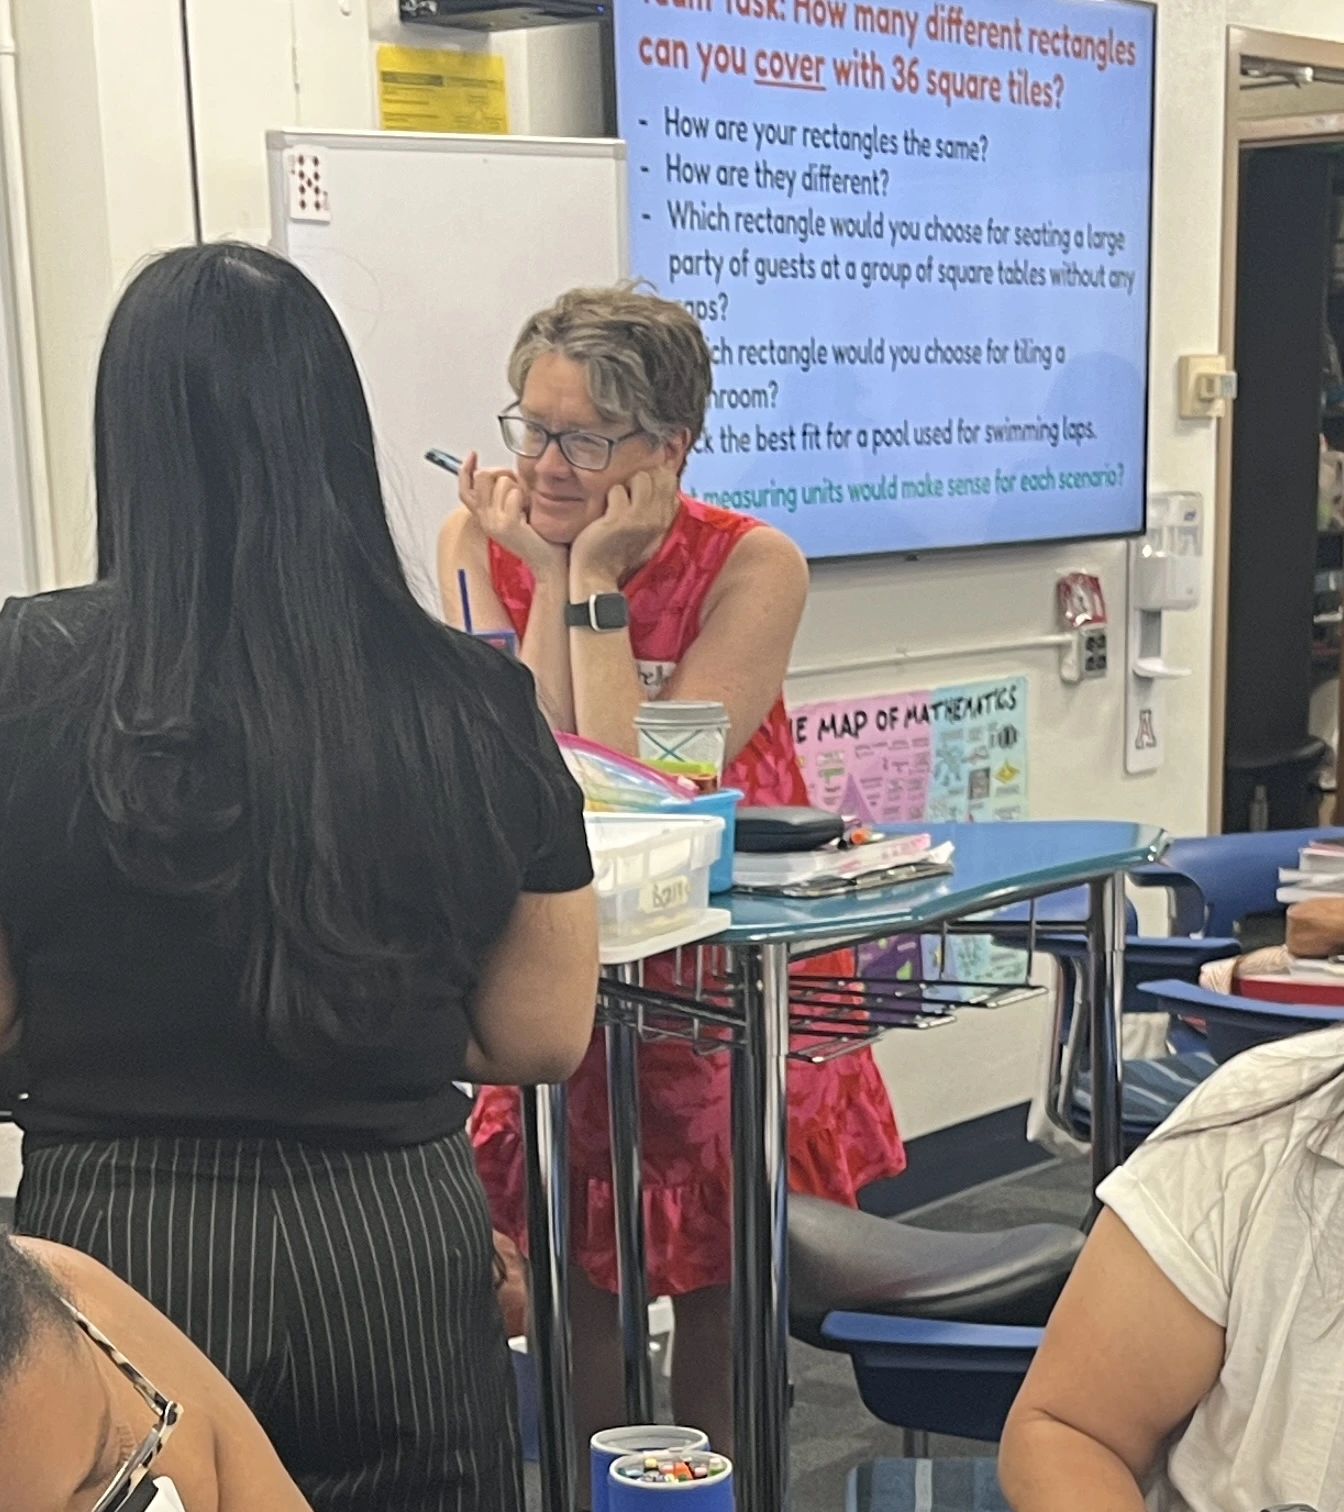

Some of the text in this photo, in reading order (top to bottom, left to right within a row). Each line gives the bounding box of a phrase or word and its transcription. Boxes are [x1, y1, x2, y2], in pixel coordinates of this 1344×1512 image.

[793, 0, 847, 29] How
[853, 3, 918, 49] many
[925, 3, 1022, 50] different
[1027, 23, 1136, 71] rectangles
[638, 36, 1065, 109] can you cover with 36 square tiles?
[664, 106, 989, 162] How are your rectangles the same?
[666, 153, 890, 198] How are they different?
[667, 199, 1125, 256] Which rectangle would you choose for seating a large
[669, 248, 1135, 295] party of guests at a group of square tables without any
[738, 337, 827, 372] rectangle
[832, 337, 885, 364] would
[889, 343, 920, 372] you
[924, 337, 983, 364] choose
[987, 337, 1009, 364] for
[1014, 338, 1052, 370] tiling
[1055, 345, 1065, 363] a
[720, 425, 751, 453] the
[756, 424, 795, 451] best
[802, 422, 821, 450] fit
[826, 421, 851, 450] for
[857, 433, 868, 449] a
[872, 420, 909, 456] pool
[914, 418, 952, 446] used
[957, 418, 980, 444] for
[985, 416, 1059, 447] swimming
[1063, 415, 1097, 447] laps.
[703, 479, 798, 512] measuring
[801, 477, 844, 505] units
[848, 474, 897, 500] would
[902, 472, 943, 498] make
[948, 474, 990, 496] sense
[994, 468, 1016, 493] for
[1020, 464, 1055, 492] each
[1059, 462, 1124, 490] scenario?
[817, 710, 867, 742] MAP
[876, 706, 898, 732] OF
[904, 685, 1017, 725] MATHEMATICS
